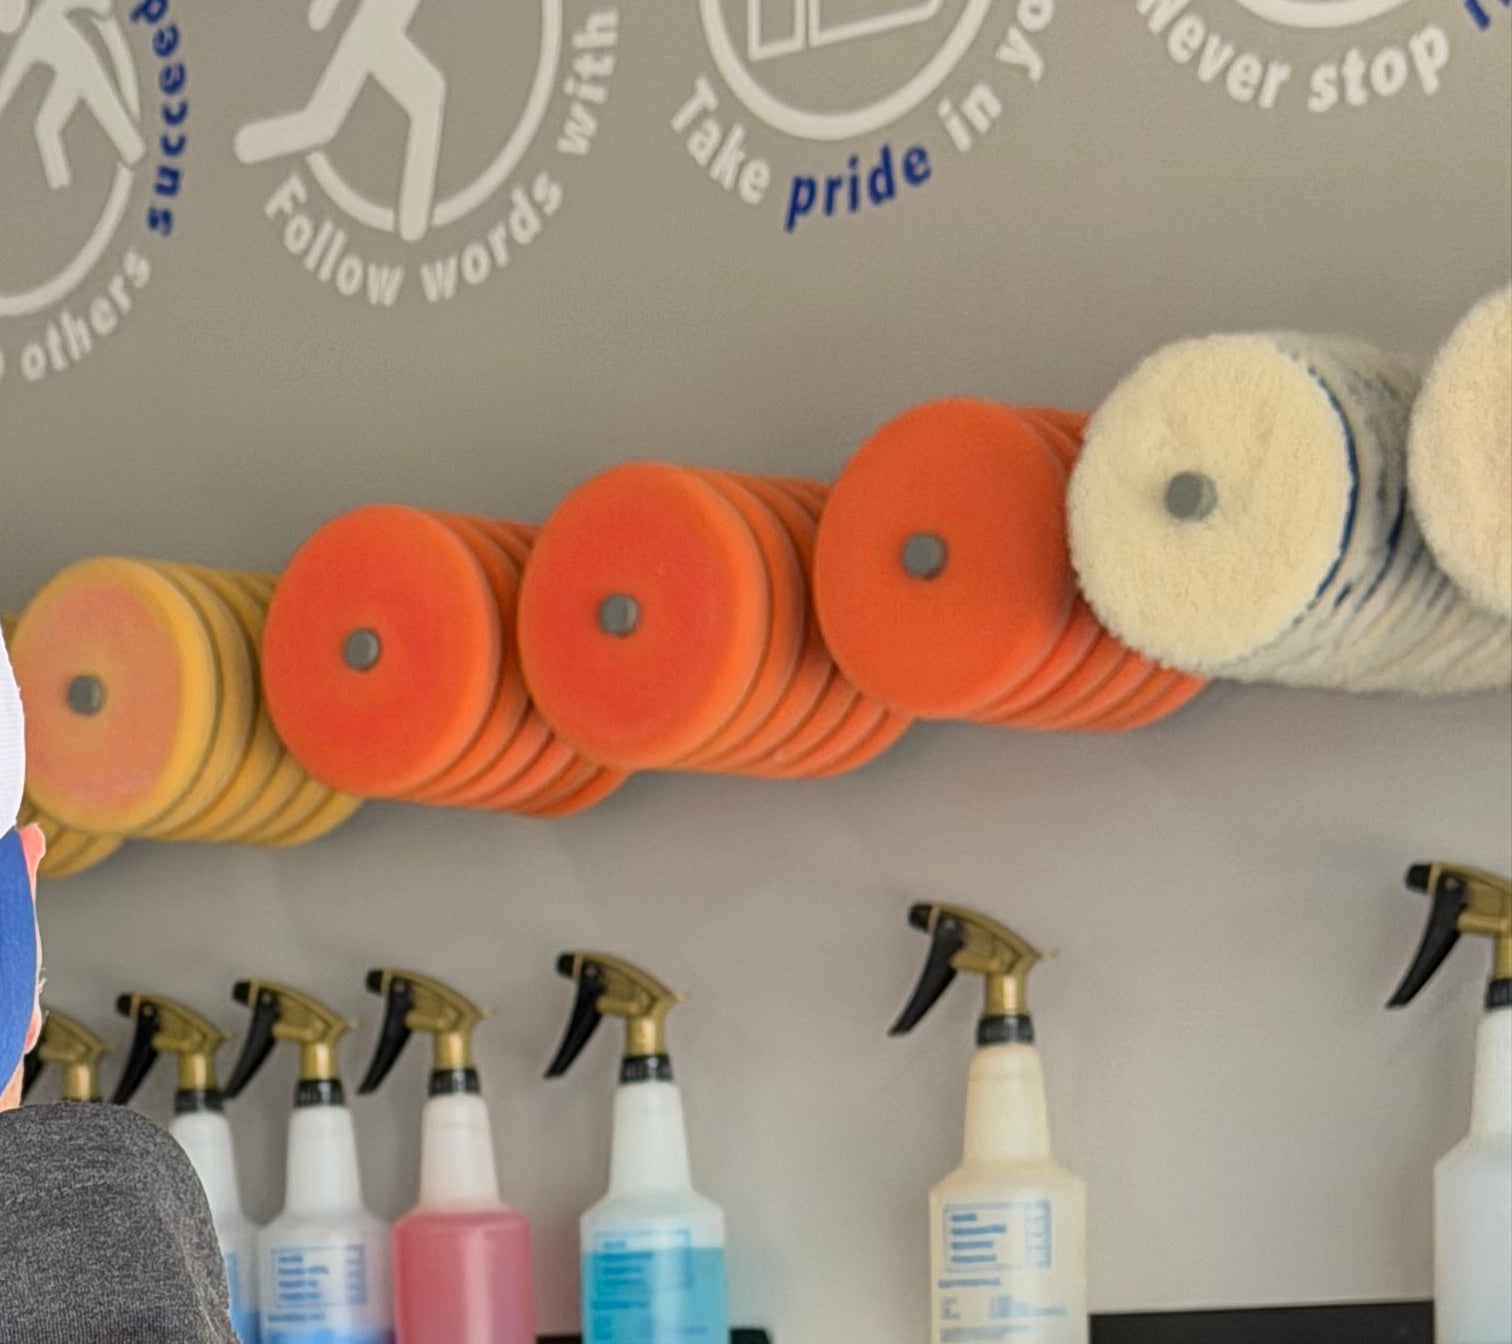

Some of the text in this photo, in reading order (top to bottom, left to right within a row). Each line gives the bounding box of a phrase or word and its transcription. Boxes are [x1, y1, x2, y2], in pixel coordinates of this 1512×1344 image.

[1306, 23, 1450, 113] stop
[264, 6, 620, 306] Follow words with
[669, 74, 772, 205] Take
[784, 144, 932, 233] pride
[937, 81, 1003, 152] in
[19, 246, 152, 382] others
